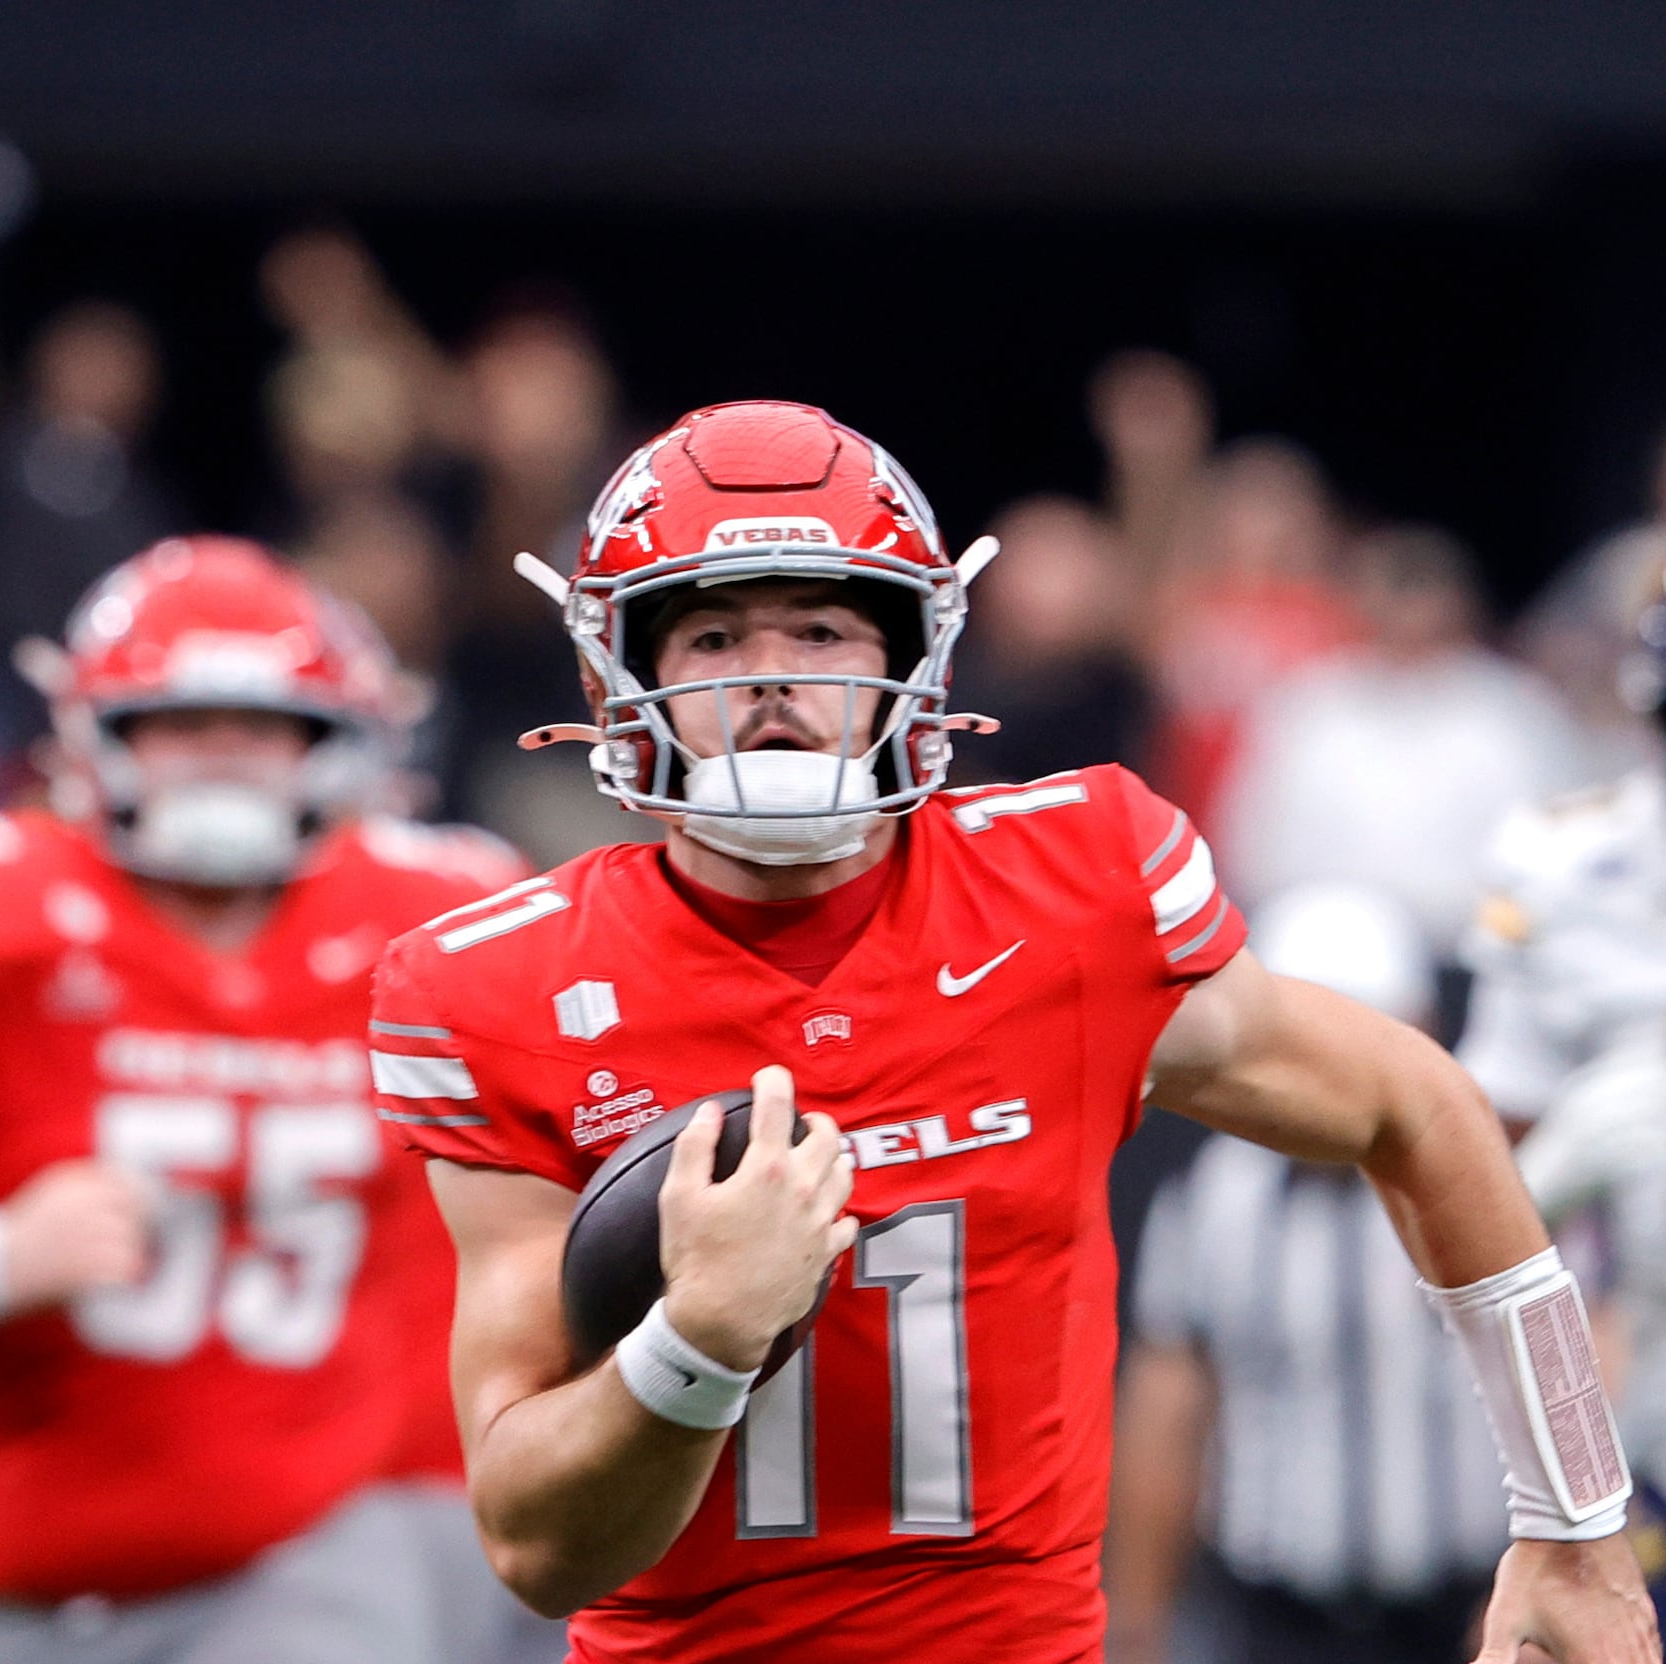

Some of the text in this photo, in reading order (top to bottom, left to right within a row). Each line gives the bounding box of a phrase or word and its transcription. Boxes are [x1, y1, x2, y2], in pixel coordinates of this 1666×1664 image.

[715, 528, 828, 546] VEGAS
[570, 1104, 666, 1147] Biologics
[573, 1088, 654, 1127] Acesso
[71, 1090, 381, 1371] 55
